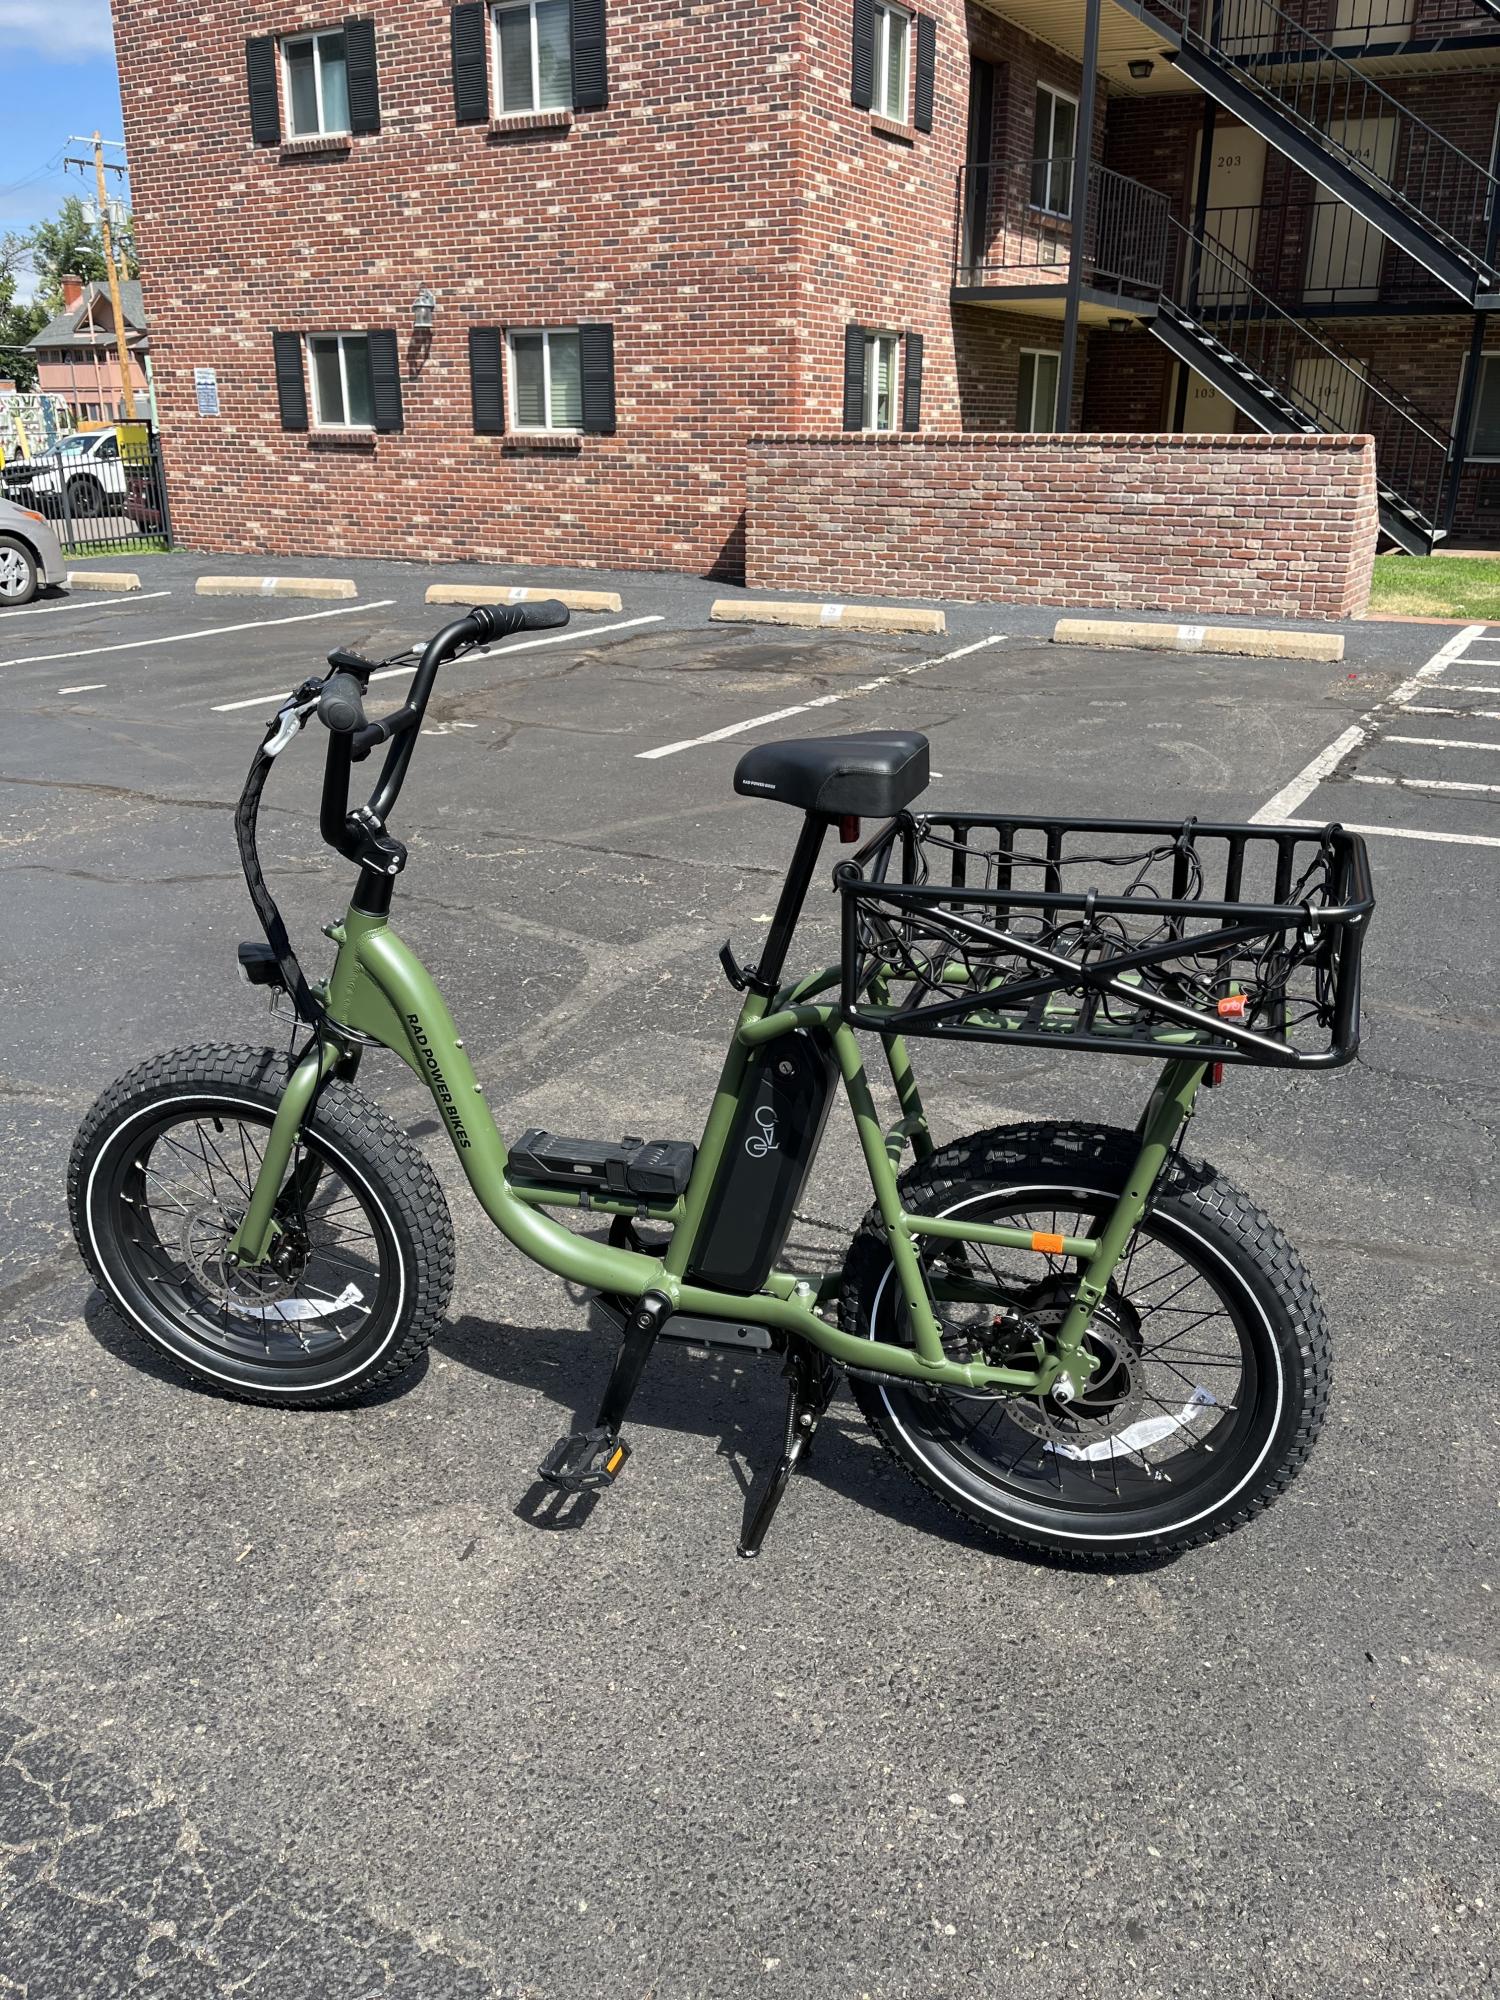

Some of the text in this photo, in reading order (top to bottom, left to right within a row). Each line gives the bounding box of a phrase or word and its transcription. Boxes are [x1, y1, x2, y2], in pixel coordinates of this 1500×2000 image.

[1217, 155, 1241, 168] 203
[1194, 388, 1216, 399] 103
[406, 1013, 472, 1149] RAD POWER BIKES
